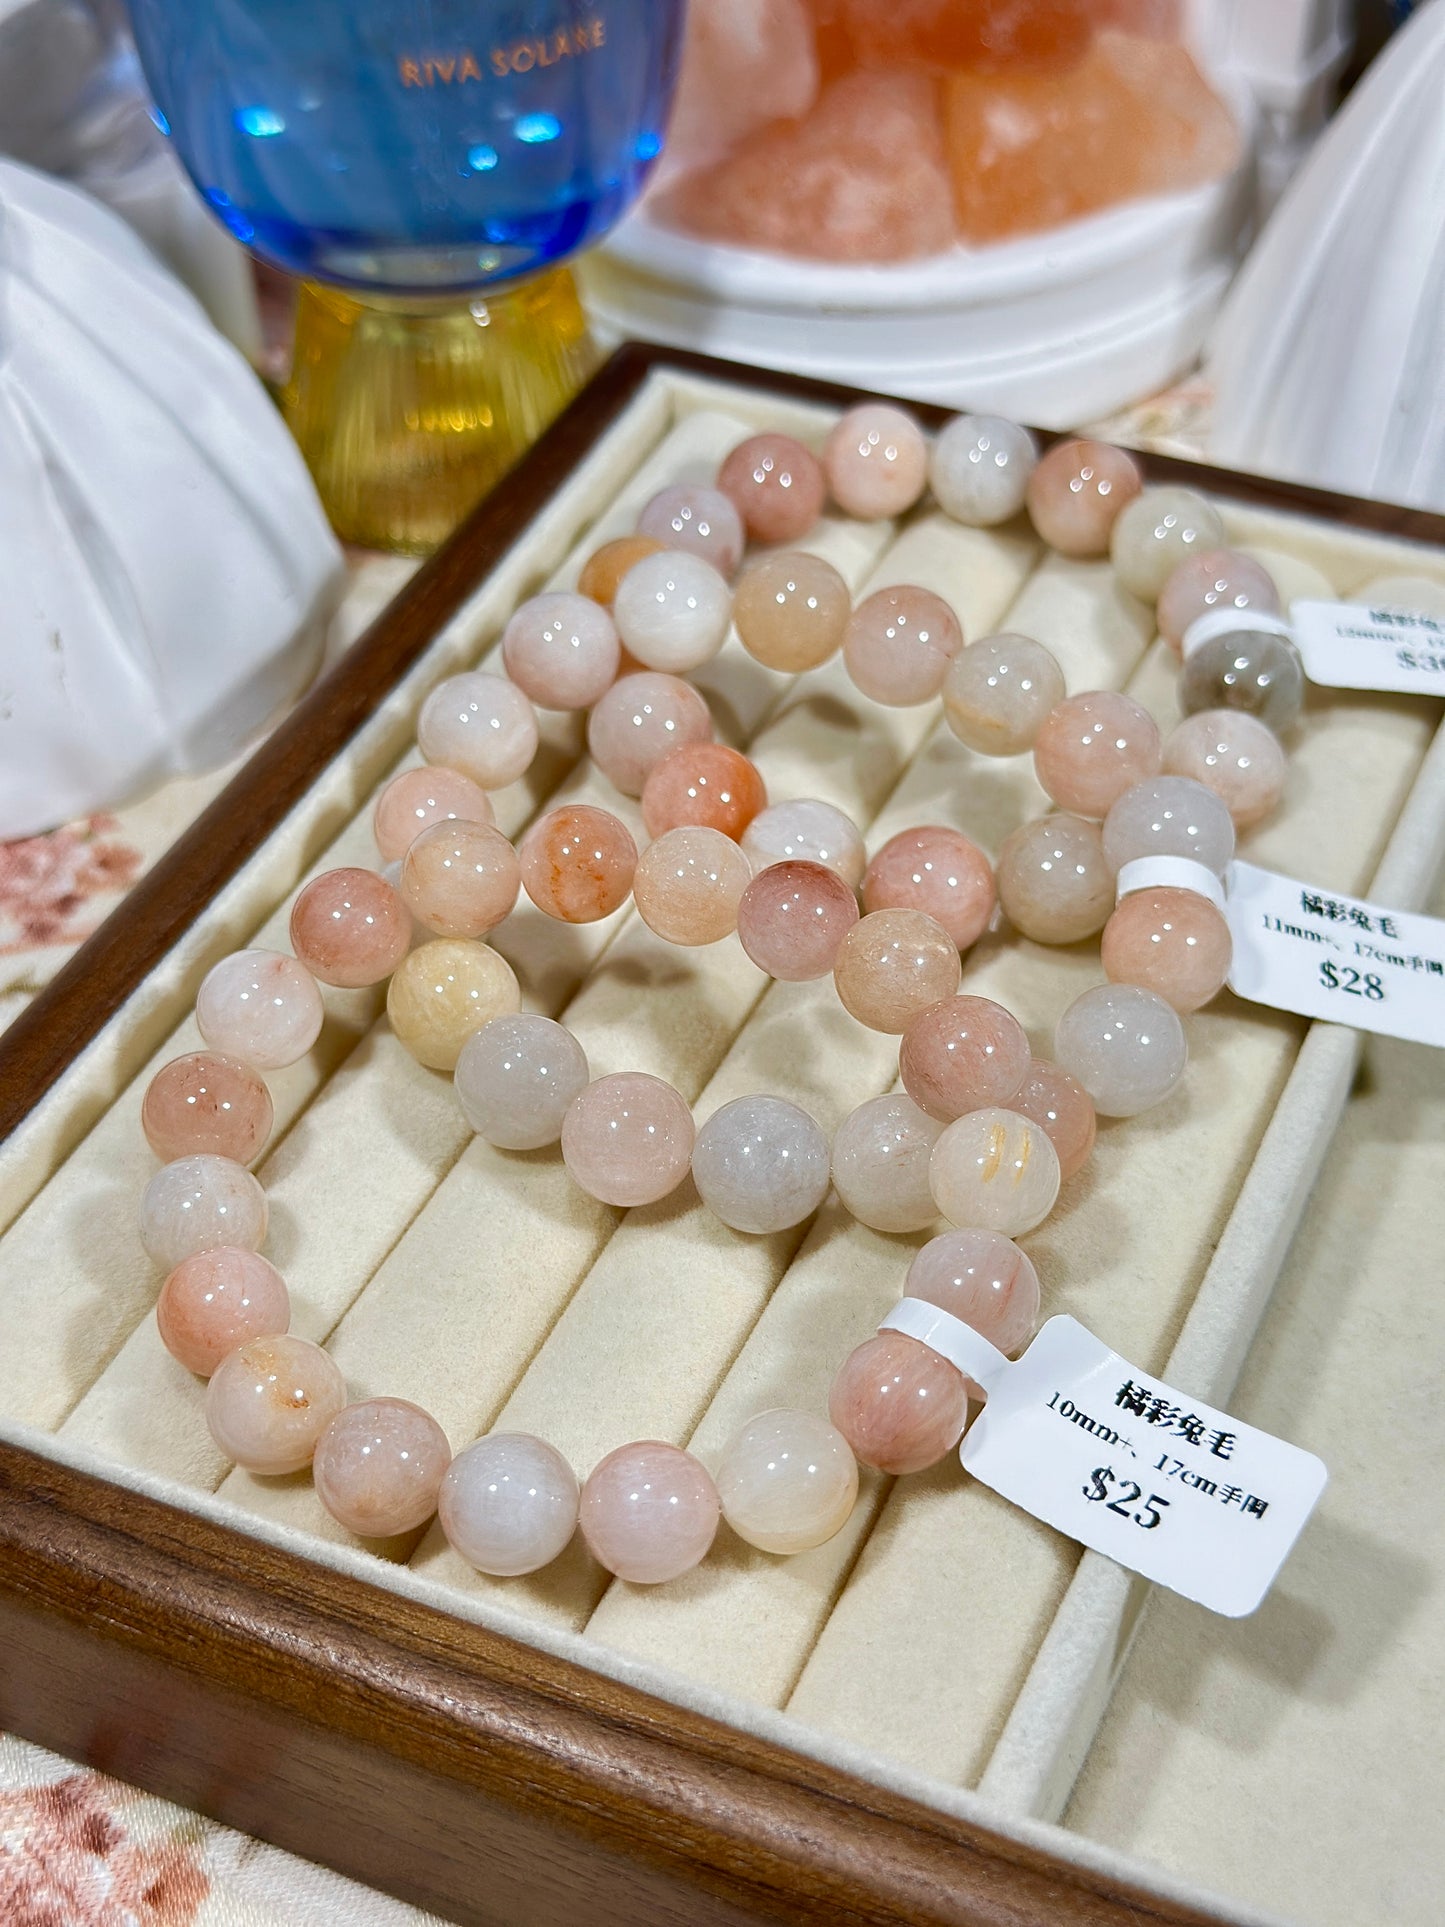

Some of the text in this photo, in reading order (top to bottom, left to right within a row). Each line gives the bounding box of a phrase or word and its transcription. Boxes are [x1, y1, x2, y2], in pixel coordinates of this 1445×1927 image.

[399, 19, 607, 88] RIVA SOLARE
[1318, 960, 1385, 1001] $28
[1114, 1379, 1237, 1460] 橘彩兔毛
[1082, 1465, 1171, 1529] $25
